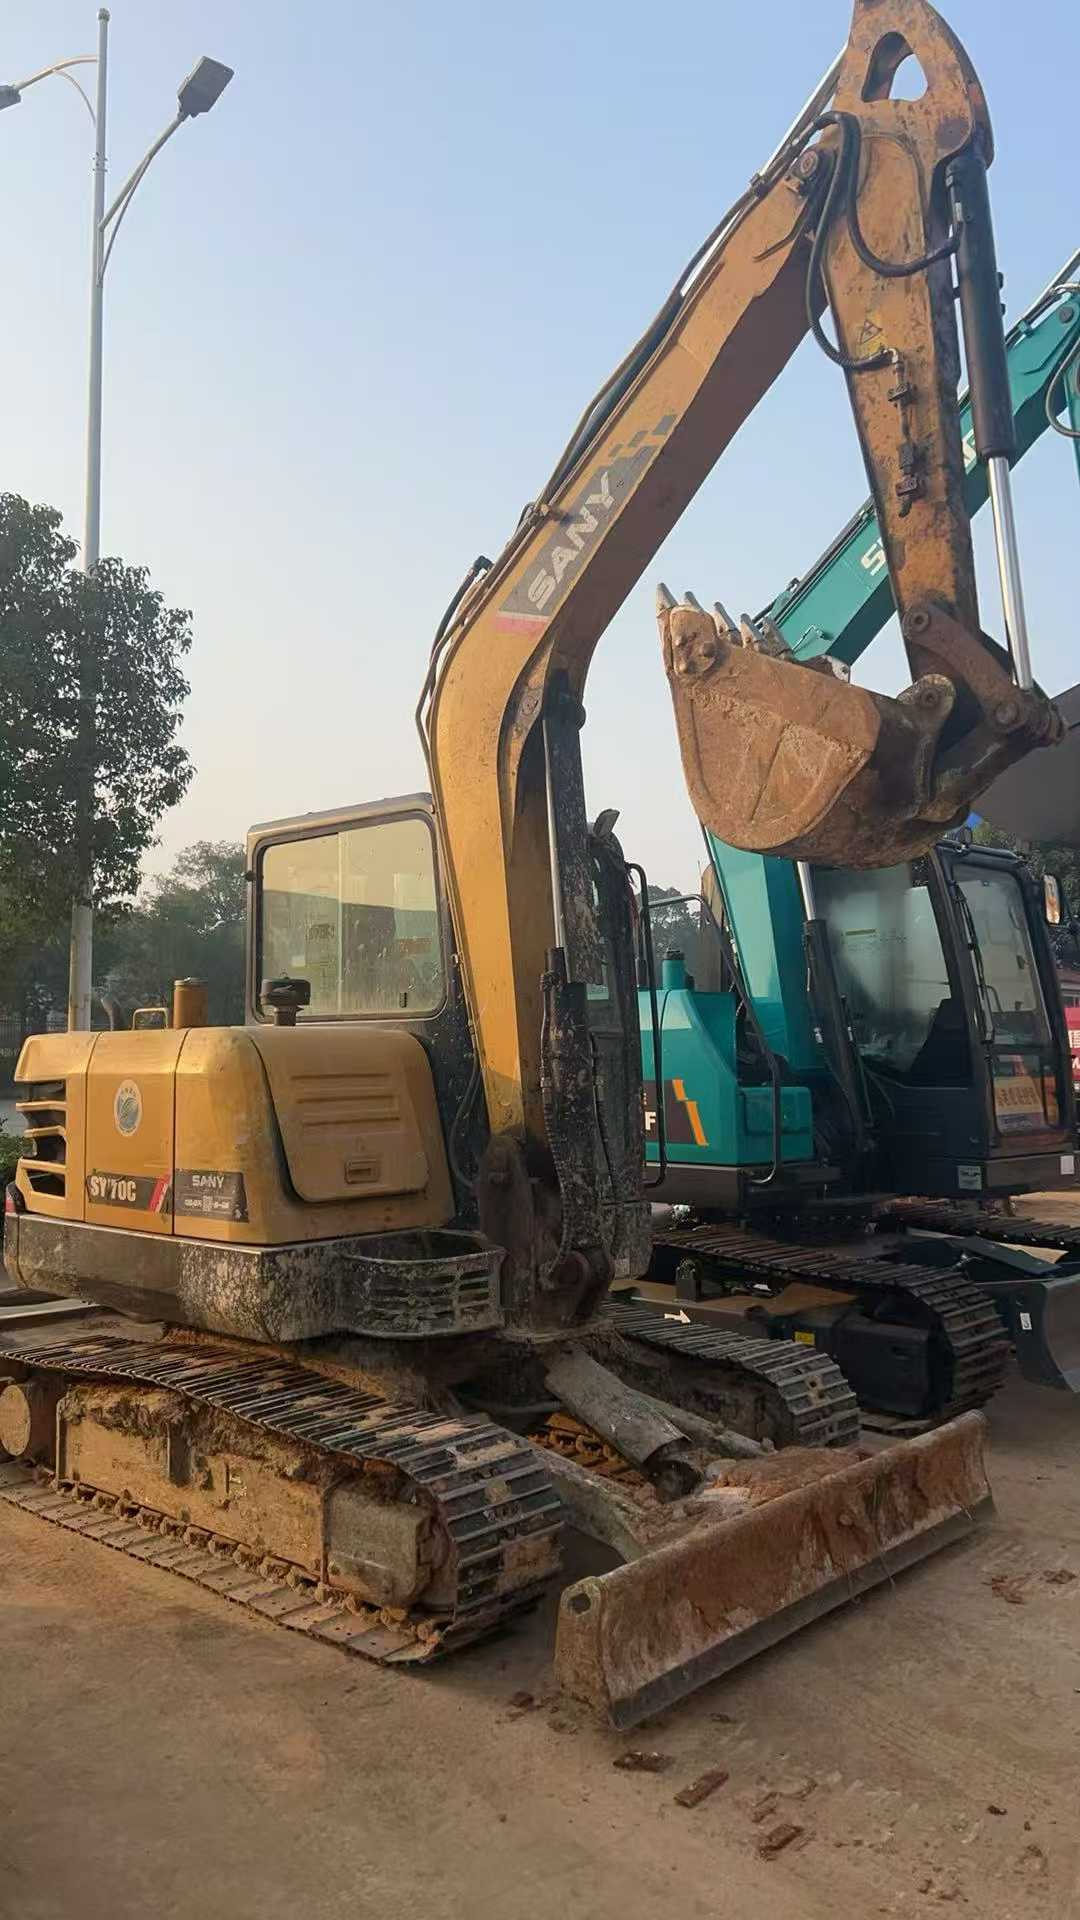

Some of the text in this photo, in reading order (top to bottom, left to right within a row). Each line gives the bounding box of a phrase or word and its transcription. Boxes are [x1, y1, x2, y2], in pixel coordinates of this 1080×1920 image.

[527, 471, 616, 610] SANY
[90, 1175, 137, 1202] SY70C
[192, 1174, 224, 1189] SANY
